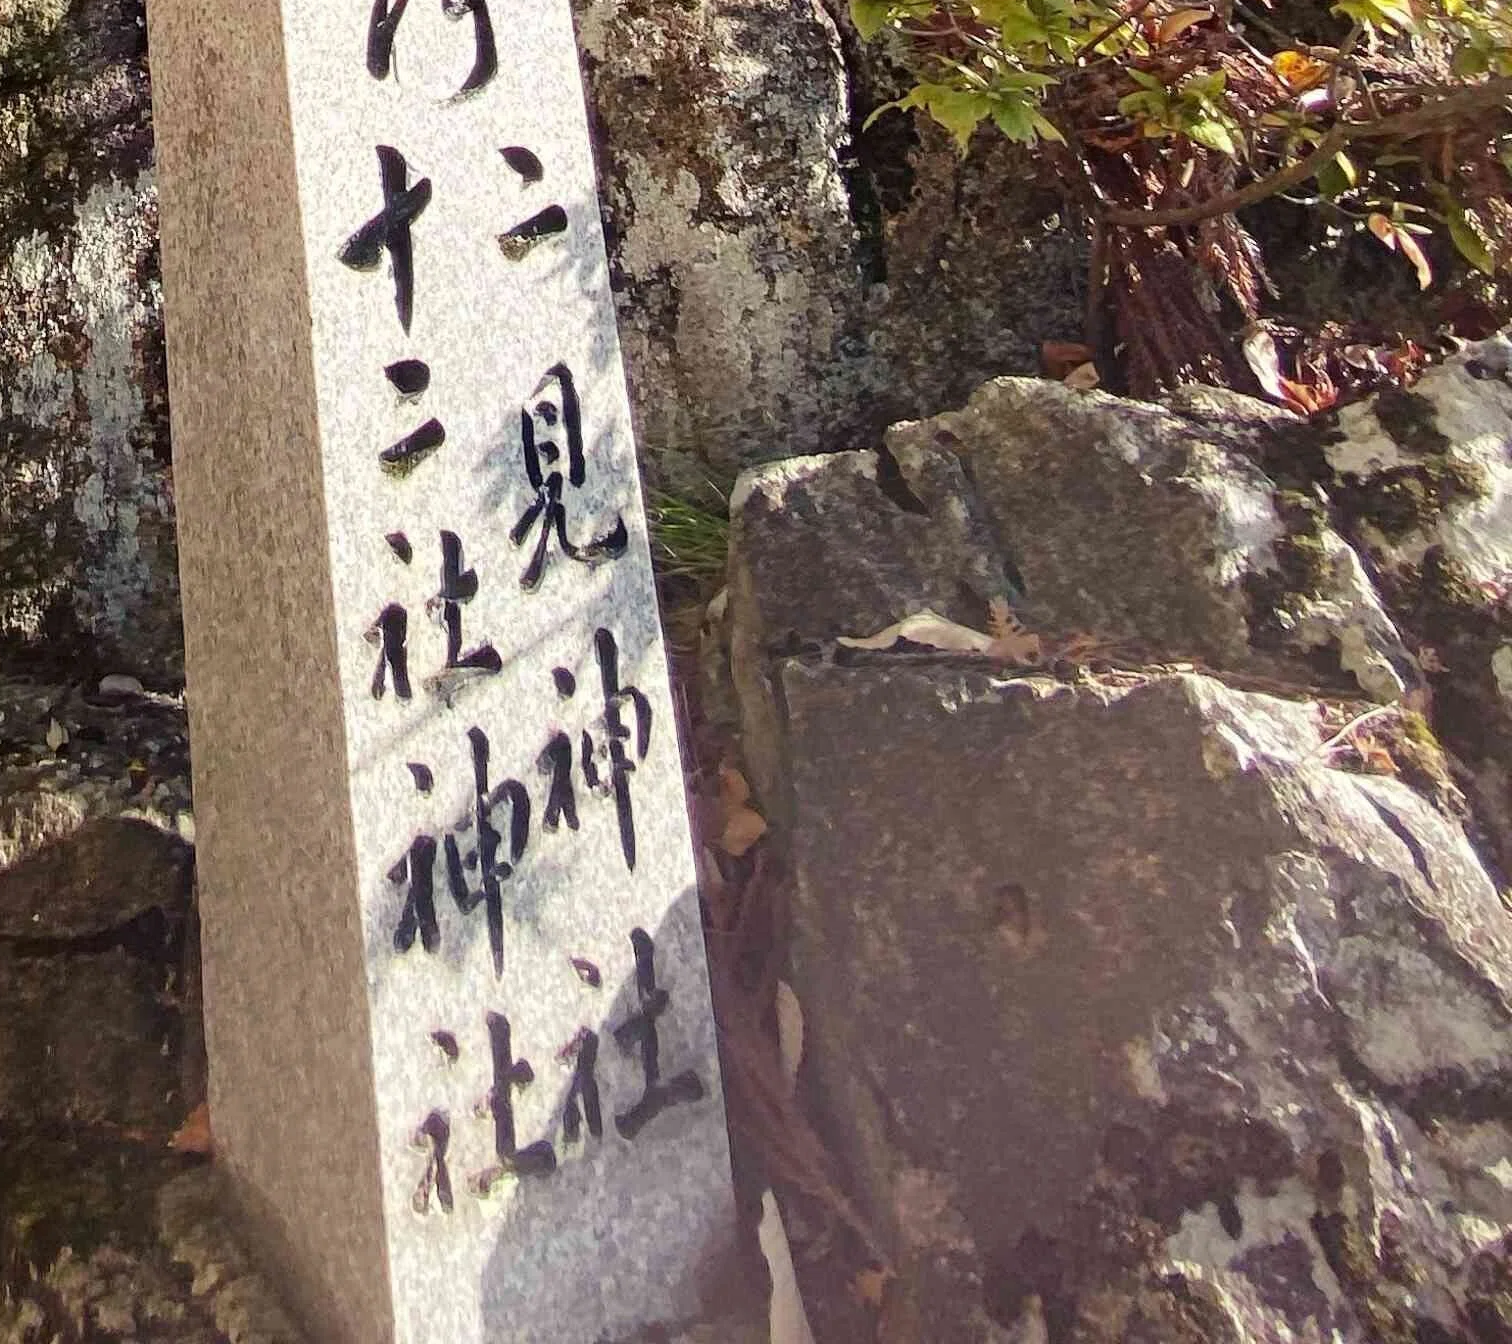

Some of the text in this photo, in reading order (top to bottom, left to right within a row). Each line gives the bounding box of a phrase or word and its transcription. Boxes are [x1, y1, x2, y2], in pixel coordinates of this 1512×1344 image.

[336, 144, 557, 1215] 十二社神社
[495, 145, 705, 1142] 二見神社
